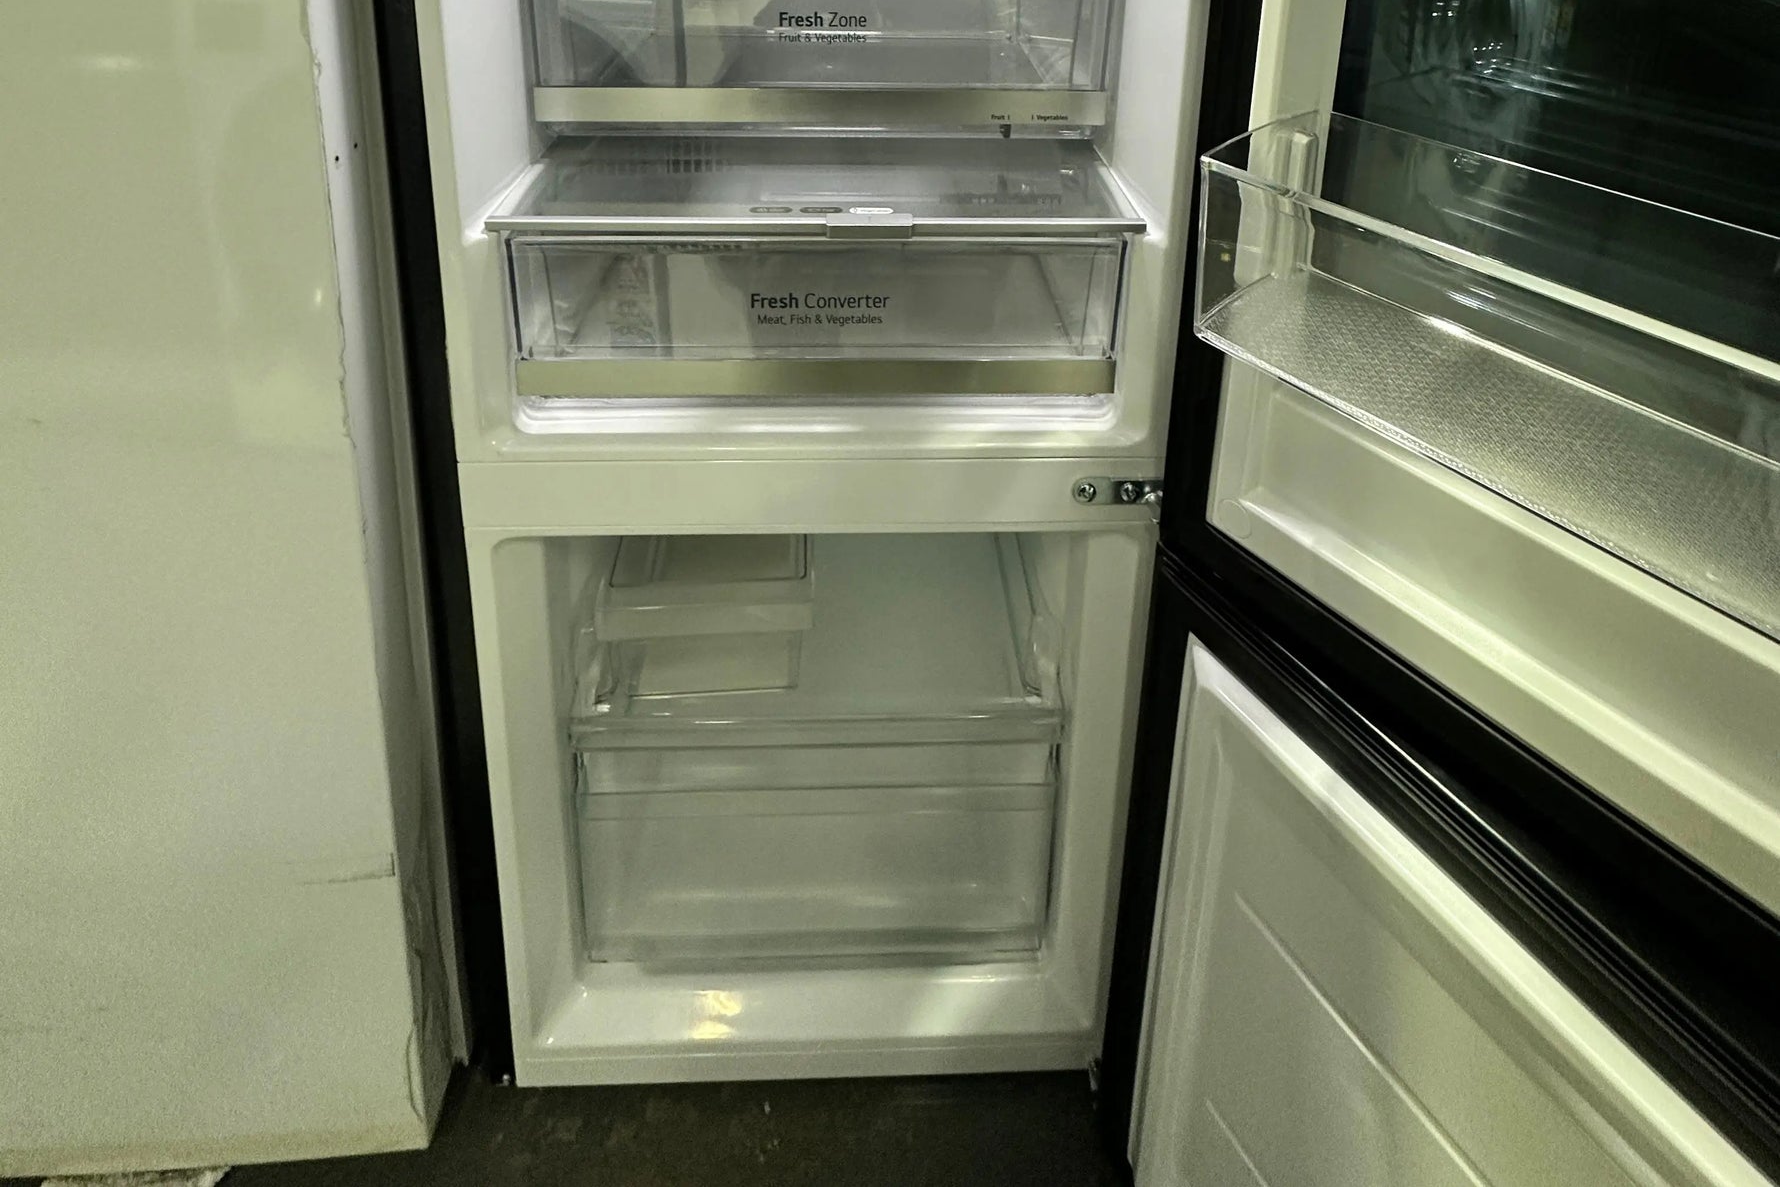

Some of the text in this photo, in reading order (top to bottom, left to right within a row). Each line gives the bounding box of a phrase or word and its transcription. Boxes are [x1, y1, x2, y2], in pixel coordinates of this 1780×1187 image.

[779, 11, 867, 28] Fresh Zone
[779, 32, 868, 45] Fruit & Vegetables
[1036, 114, 1069, 122] Vegetables
[750, 293, 890, 309] Fresh Converter
[757, 314, 883, 327] Meat, Fish & Vegetables
